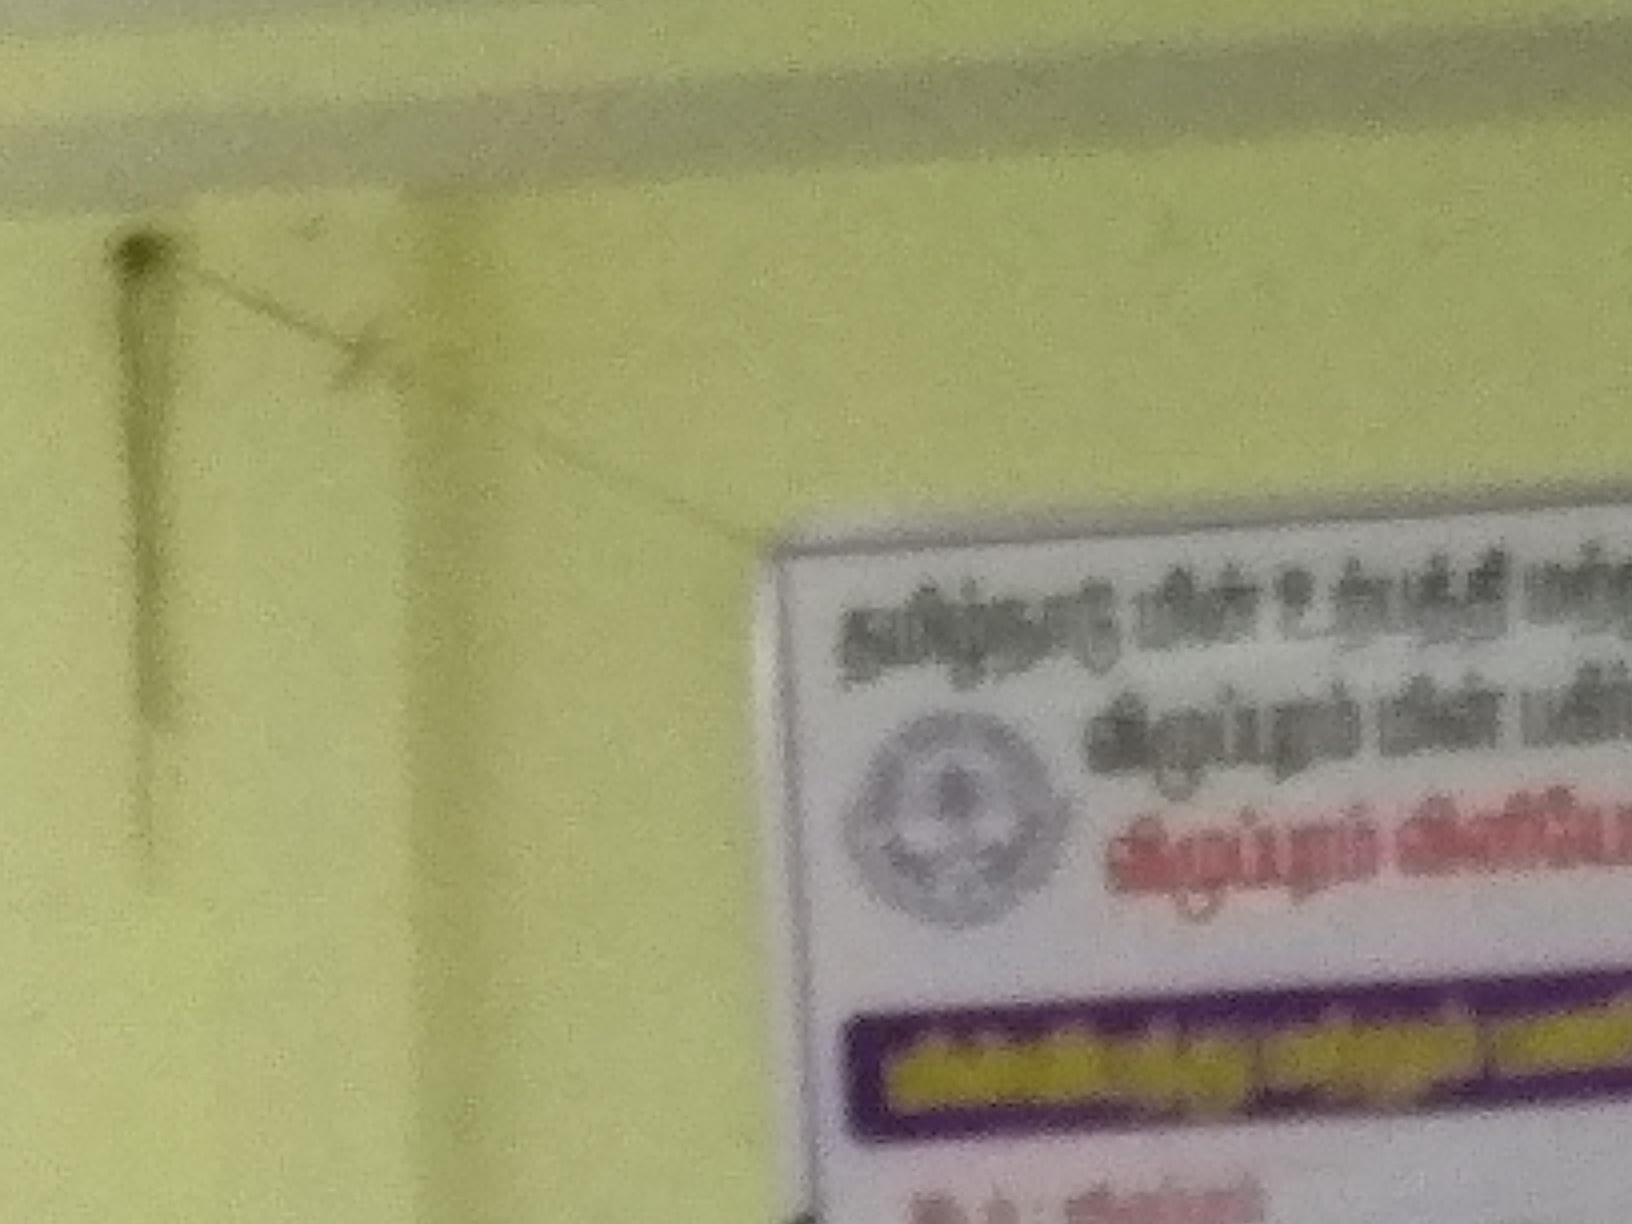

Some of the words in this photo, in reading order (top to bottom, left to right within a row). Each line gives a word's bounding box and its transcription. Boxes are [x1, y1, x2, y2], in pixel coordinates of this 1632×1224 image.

[1135, 562, 1260, 652] மின்
[1377, 670, 1505, 758] மின்
[1105, 802, 1382, 925] விழுப்புரம்
